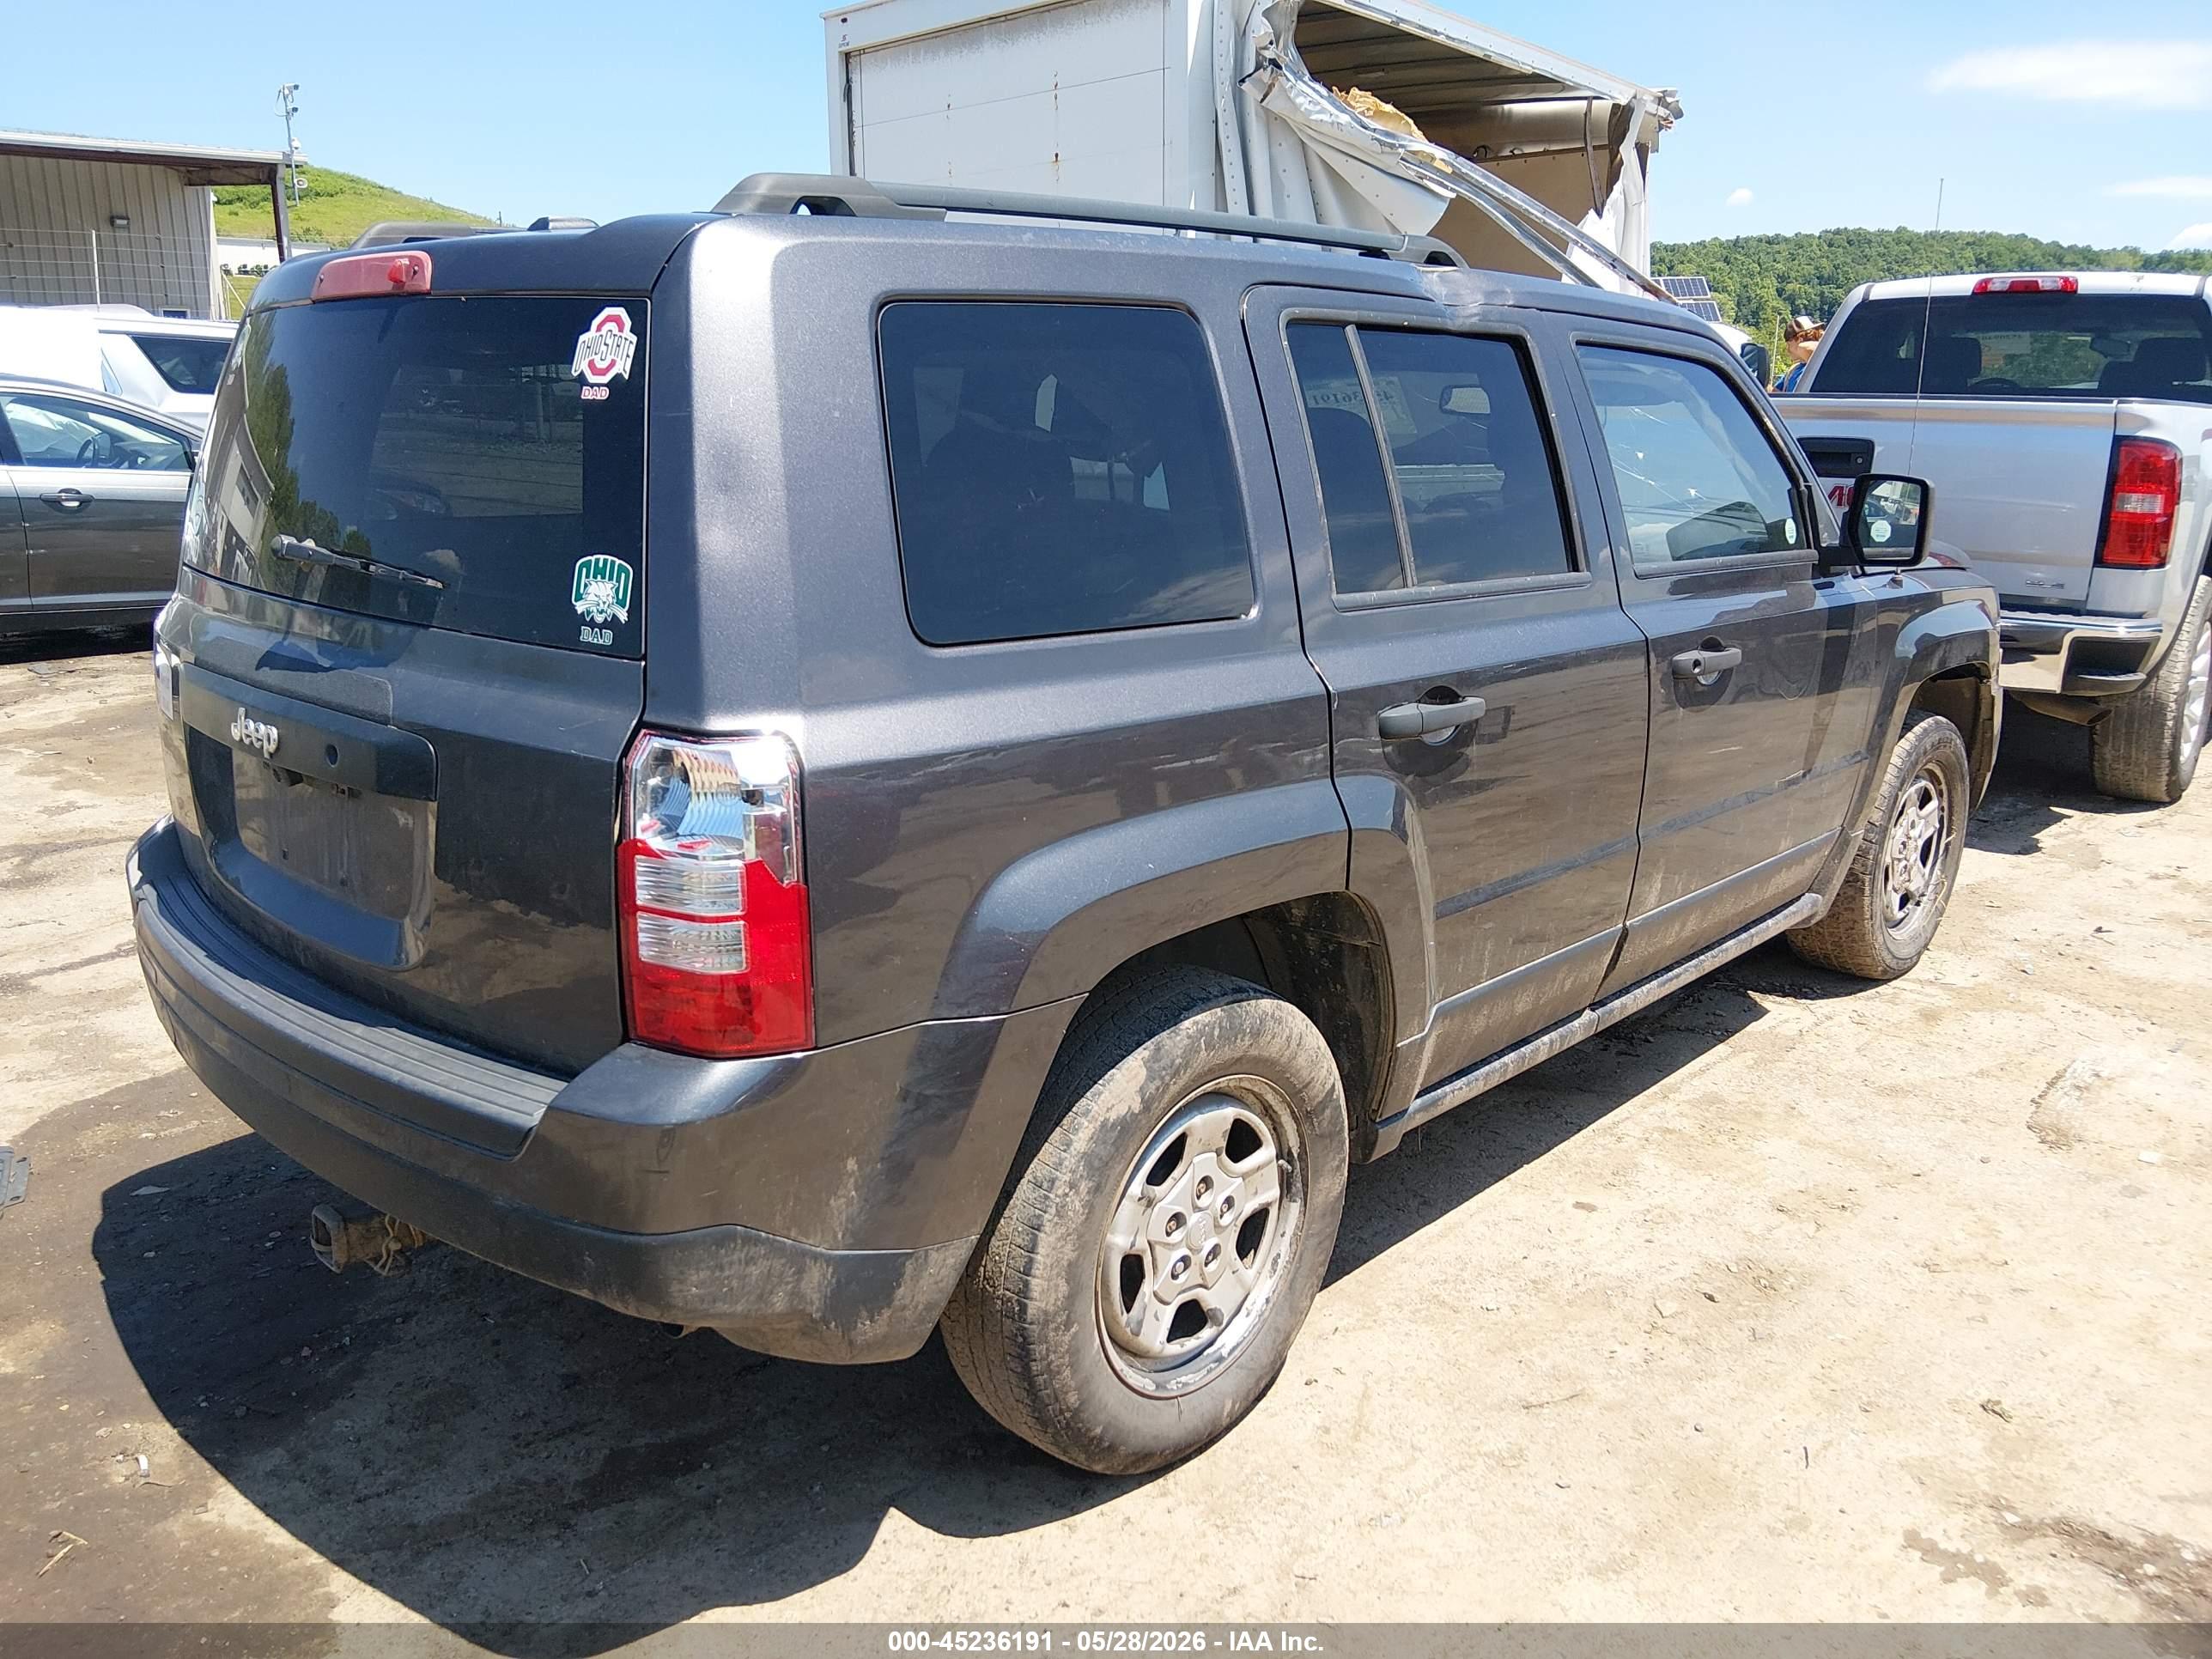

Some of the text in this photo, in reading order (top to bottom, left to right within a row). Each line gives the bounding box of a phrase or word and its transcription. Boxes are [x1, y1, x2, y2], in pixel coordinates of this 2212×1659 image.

[574, 329, 635, 374] OHIO STATE
[581, 386, 609, 399] DAD
[573, 556, 633, 609] OHIO
[580, 626, 613, 645] DAD
[231, 707, 278, 759] Jeep
